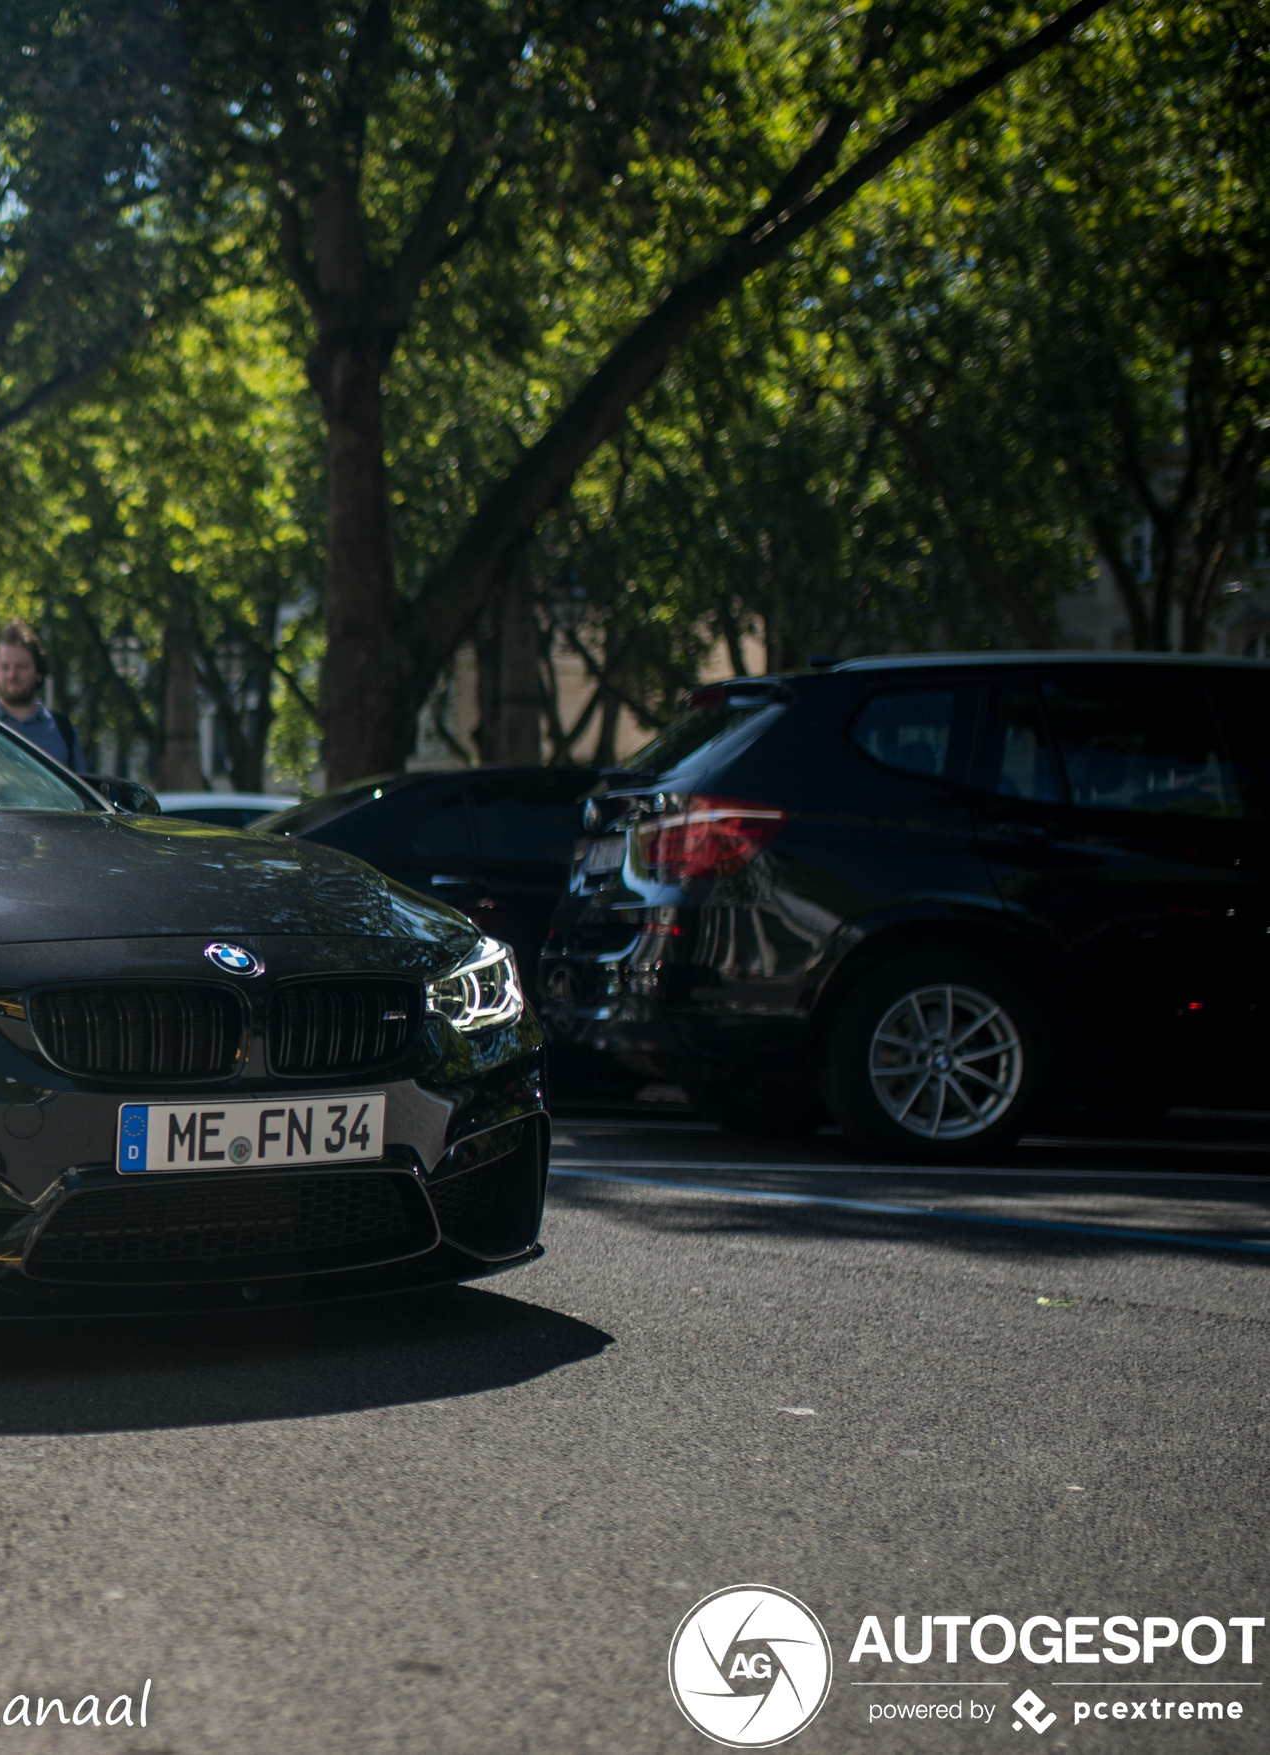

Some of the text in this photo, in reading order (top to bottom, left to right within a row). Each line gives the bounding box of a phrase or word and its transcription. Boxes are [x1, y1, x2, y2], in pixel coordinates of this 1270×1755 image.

[167, 1103, 371, 1163] ME FN 34
[128, 1145, 139, 1160] D
